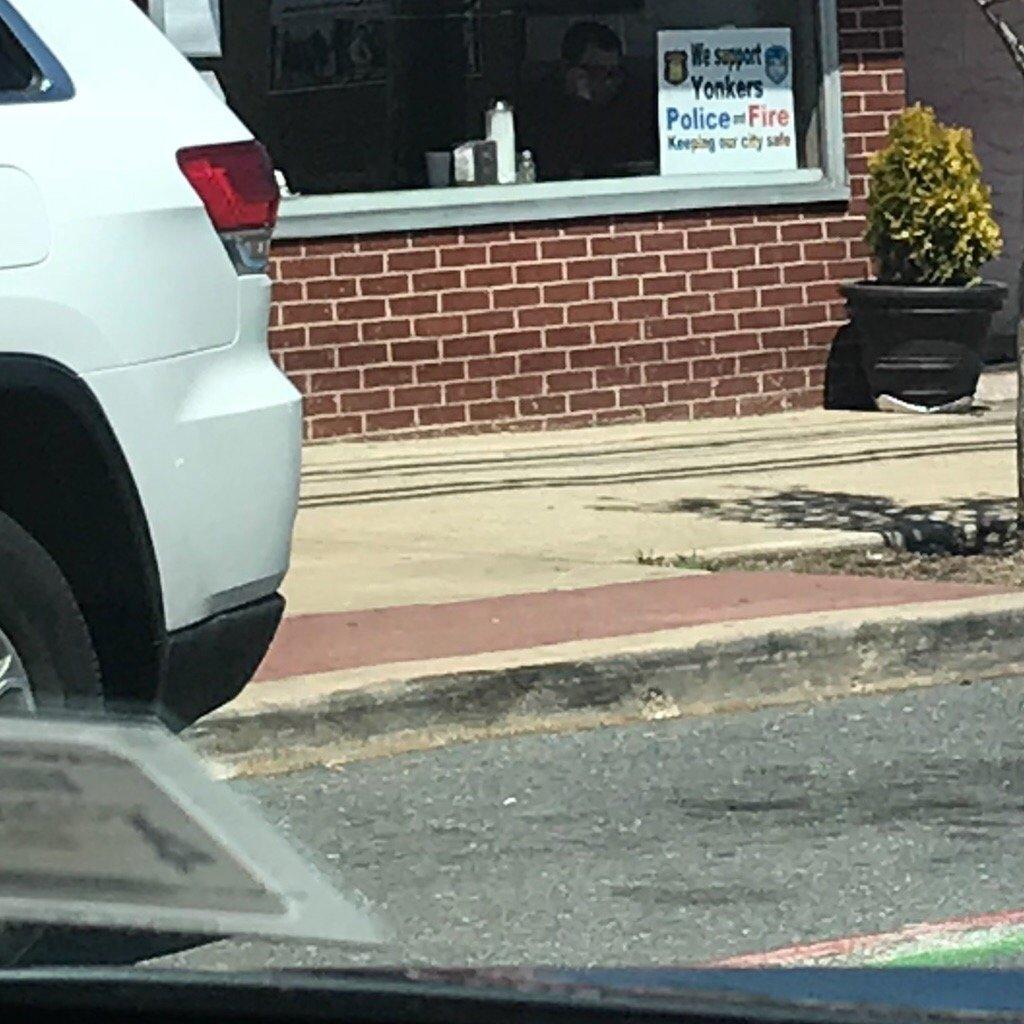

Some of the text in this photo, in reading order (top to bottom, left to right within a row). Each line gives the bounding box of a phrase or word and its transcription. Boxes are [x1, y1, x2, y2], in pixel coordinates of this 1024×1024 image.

[691, 42, 762, 70] We support
[691, 75, 764, 100] Yonkers
[666, 107, 731, 130] Police
[748, 104, 790, 127] Fire
[668, 135, 716, 153] Keeping
